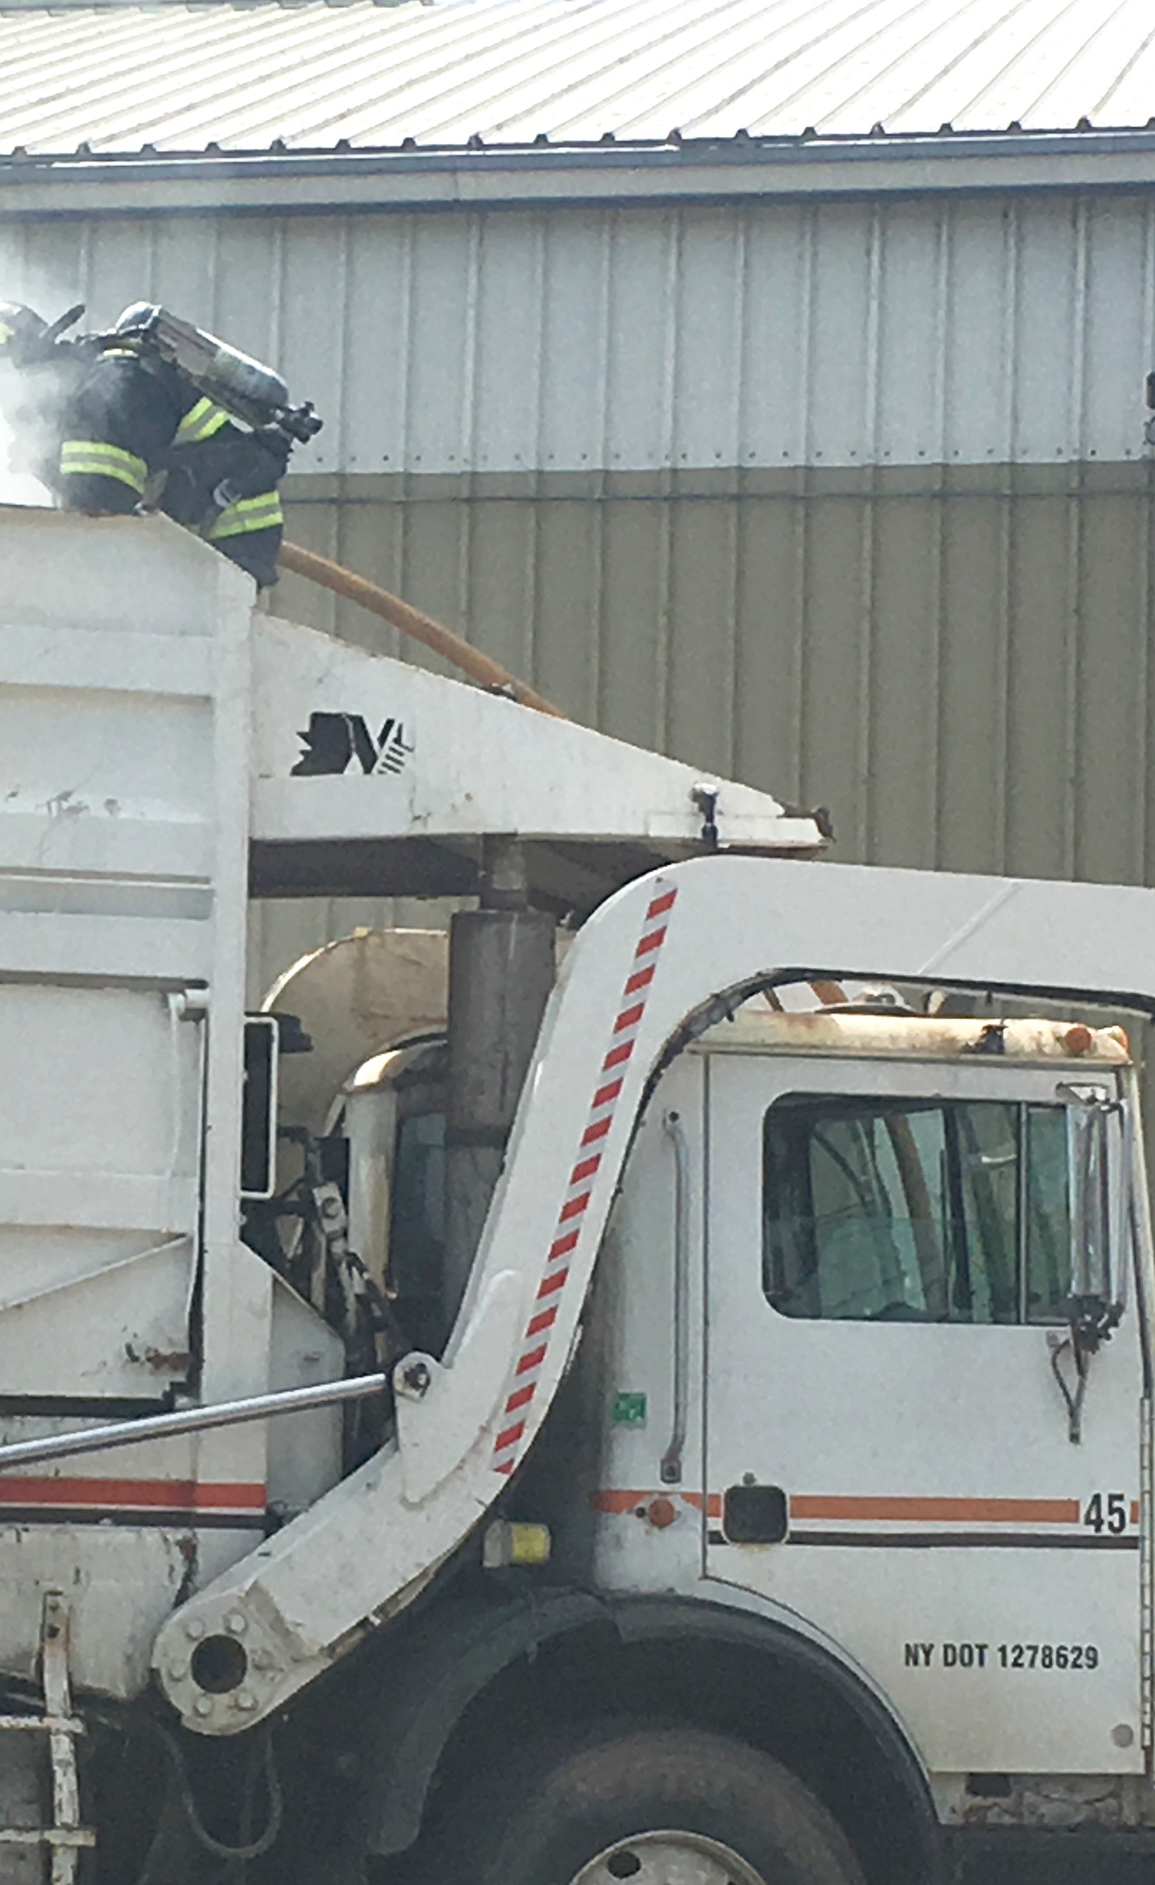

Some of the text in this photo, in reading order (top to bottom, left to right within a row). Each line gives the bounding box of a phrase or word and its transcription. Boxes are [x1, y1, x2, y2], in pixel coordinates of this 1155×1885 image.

[1083, 1493, 1127, 1534] 45
[904, 1643, 1099, 1670] NY DOT 1278629
